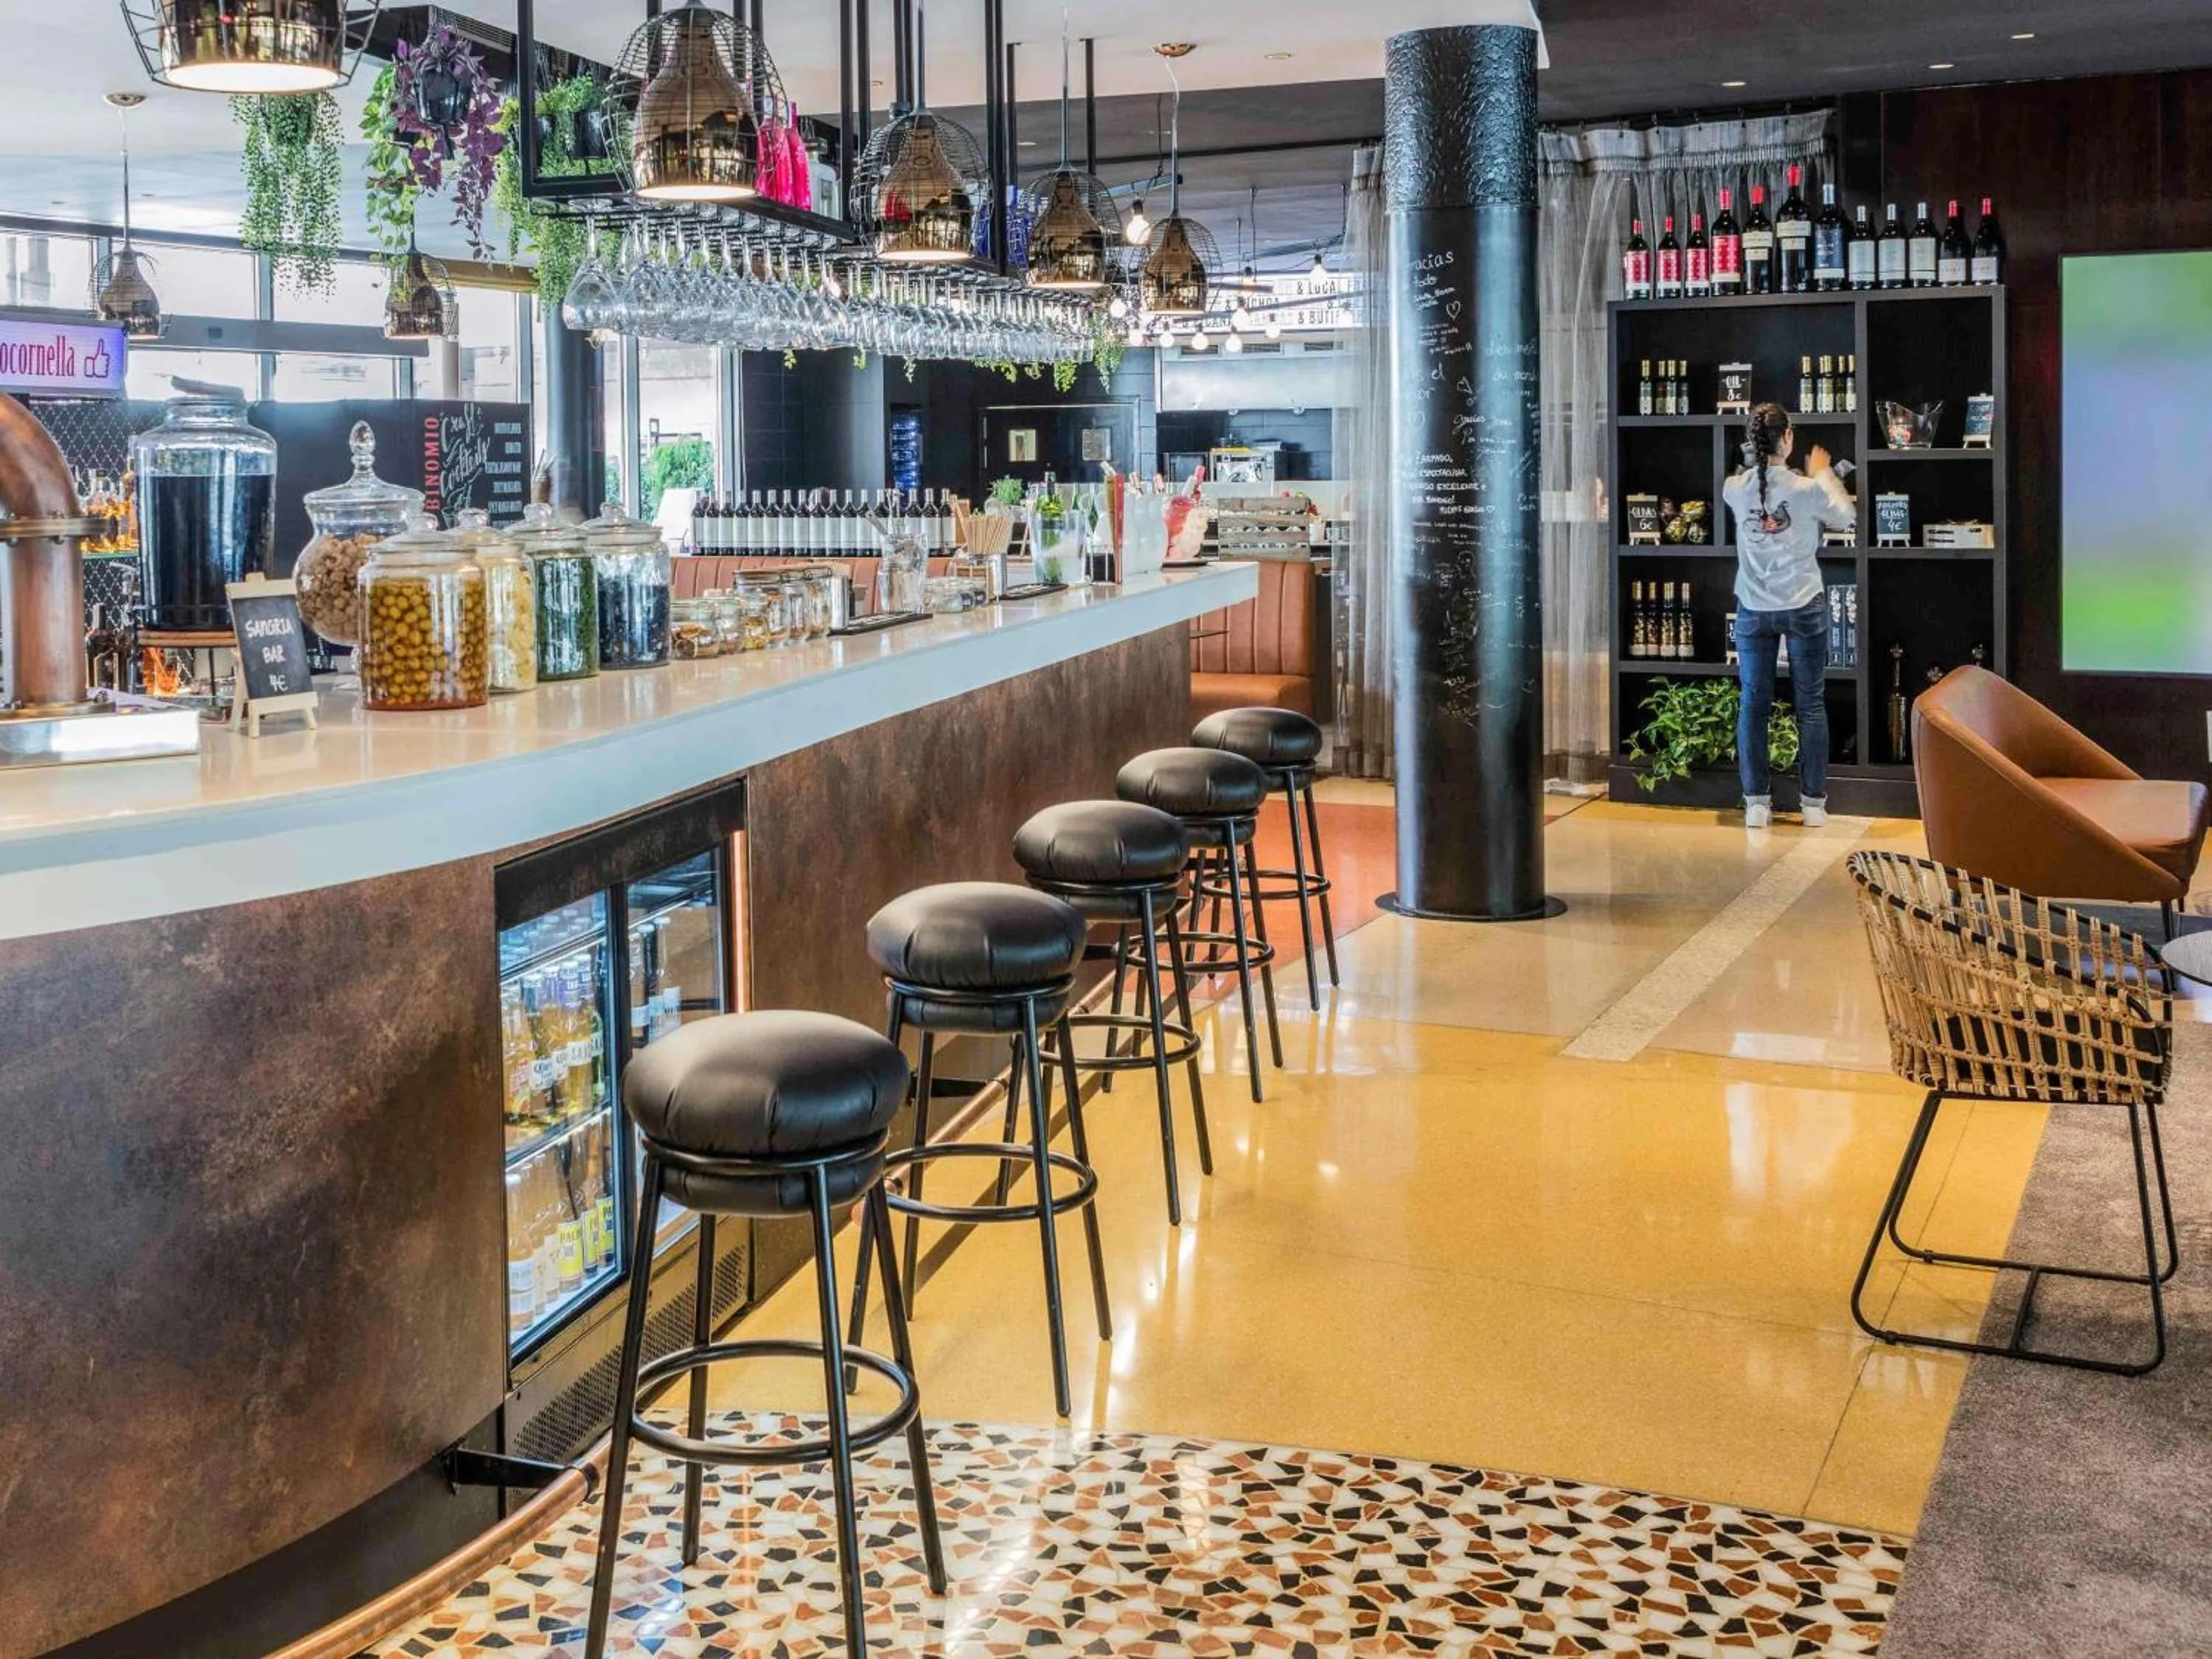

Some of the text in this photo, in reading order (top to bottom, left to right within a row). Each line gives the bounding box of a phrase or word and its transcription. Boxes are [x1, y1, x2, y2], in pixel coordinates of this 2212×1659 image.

[0, 335, 75, 377] ocornella
[424, 417, 440, 511] BINOMIO
[245, 617, 295, 638] SANGRIA
[262, 644, 287, 664] BAR
[269, 674, 288, 692] 4€
